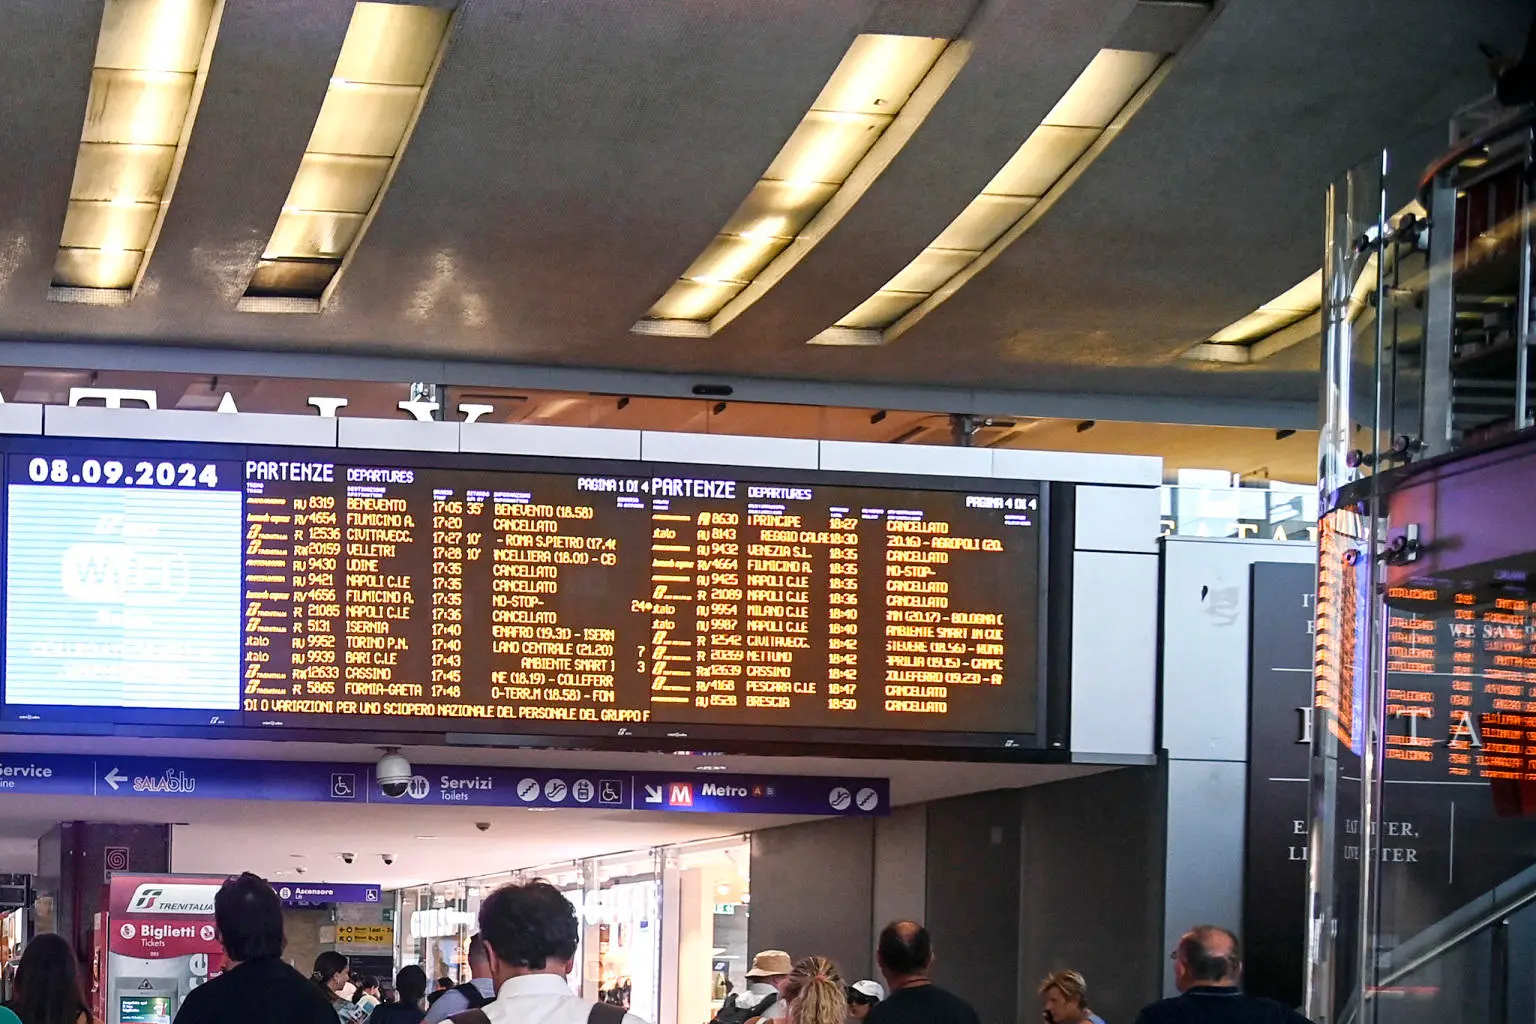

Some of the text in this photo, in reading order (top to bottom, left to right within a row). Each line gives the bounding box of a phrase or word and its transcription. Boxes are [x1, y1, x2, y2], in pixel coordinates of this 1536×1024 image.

[27, 459, 217, 490] 08.09.2024
[246, 461, 333, 484] PARTENZE
[347, 469, 413, 483] DEPARTURES
[578, 478, 648, 493] PAGINA 1 DI 4
[652, 478, 735, 498] PARTENZE
[748, 487, 811, 499] DEPARTURES
[309, 496, 334, 509] 8319
[347, 498, 406, 511] BENEVENTO
[434, 499, 462, 513] 17:05
[495, 504, 553, 517] BENEVENTO
[556, 506, 593, 519] (18.58)
[830, 548, 857, 560] 18:35
[886, 550, 948, 563] CANCELLATO
[309, 558, 557, 578] 9430 UDINE 17:35 CANCELLATO
[308, 620, 461, 636] 5131 ISERNIA 17:40
[307, 635, 335, 647] 9952
[346, 636, 384, 649] TORINO
[387, 637, 408, 649] P.N.
[432, 639, 461, 651] 17:40
[522, 642, 573, 655] CENTRALE
[576, 644, 613, 656] (21.20)
[638, 646, 645, 657] 7
[346, 652, 606, 671] BARI C.LE 17:43 AMBIENTE SMART
[272, 700, 641, 721] VARIAZIONI PER UNO SCIOPERO NAZIONALE DEL PERSONALE DEL GRUPPO
[828, 699, 856, 709] 18:50
[885, 701, 947, 712] CANCELLATO
[440, 777, 492, 790] Servizi
[702, 783, 747, 797] Metro
[441, 790, 468, 801] Toilets
[159, 902, 213, 911] TRENITALIA
[141, 925, 196, 938] Biglietti
[141, 938, 165, 947] Tickets
